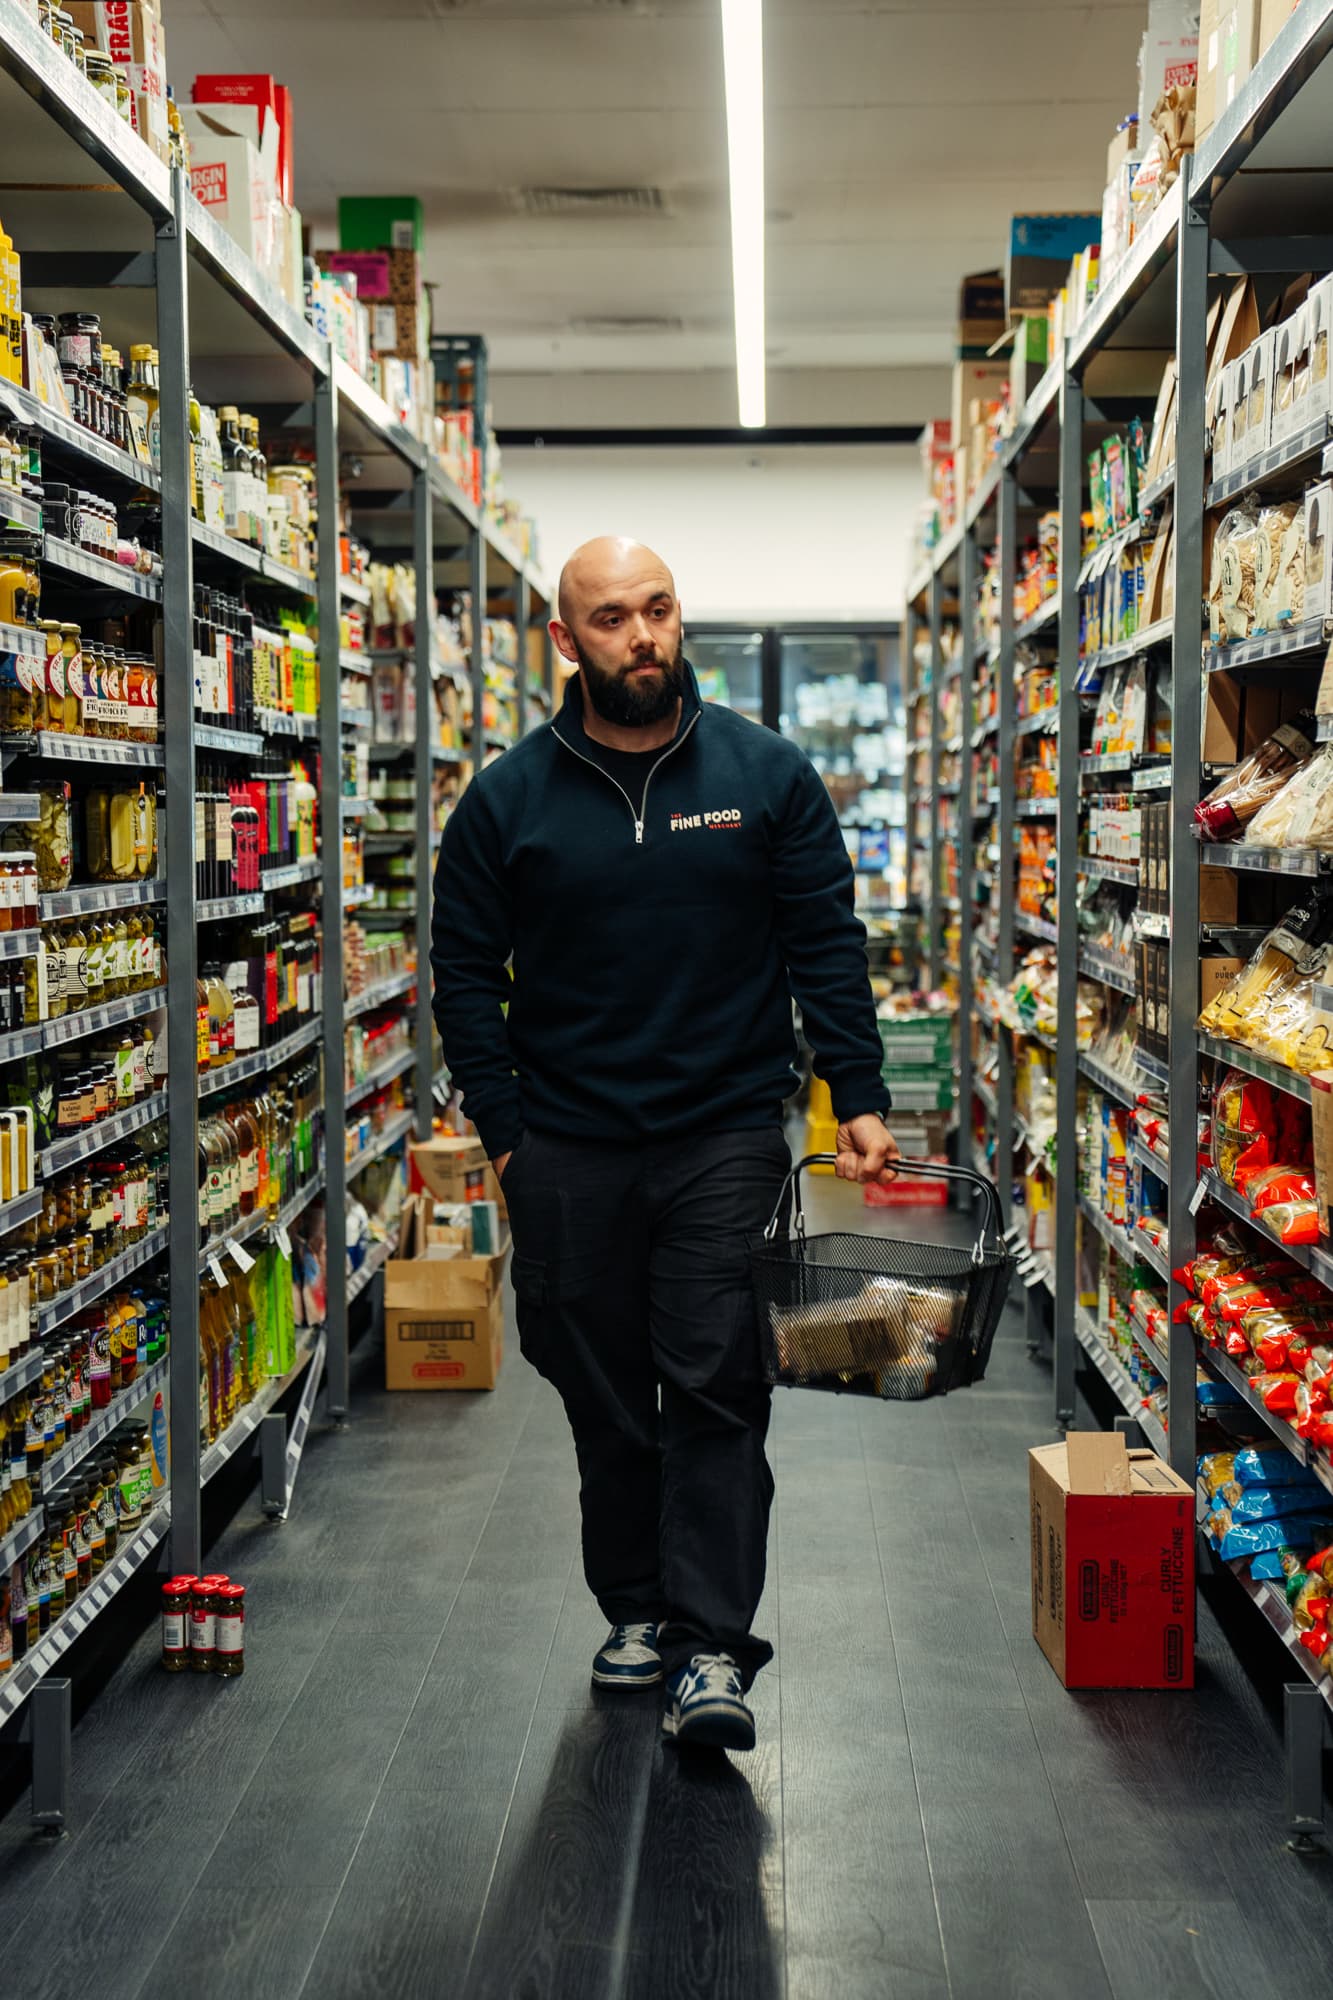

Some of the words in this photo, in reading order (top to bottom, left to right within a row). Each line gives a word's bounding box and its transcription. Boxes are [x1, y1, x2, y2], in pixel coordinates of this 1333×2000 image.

[670, 815, 702, 831] FINE
[703, 809, 742, 825] FOOD
[1160, 1547, 1172, 1592] CURLY
[1171, 1527, 1184, 1615] FETTUCCINE
